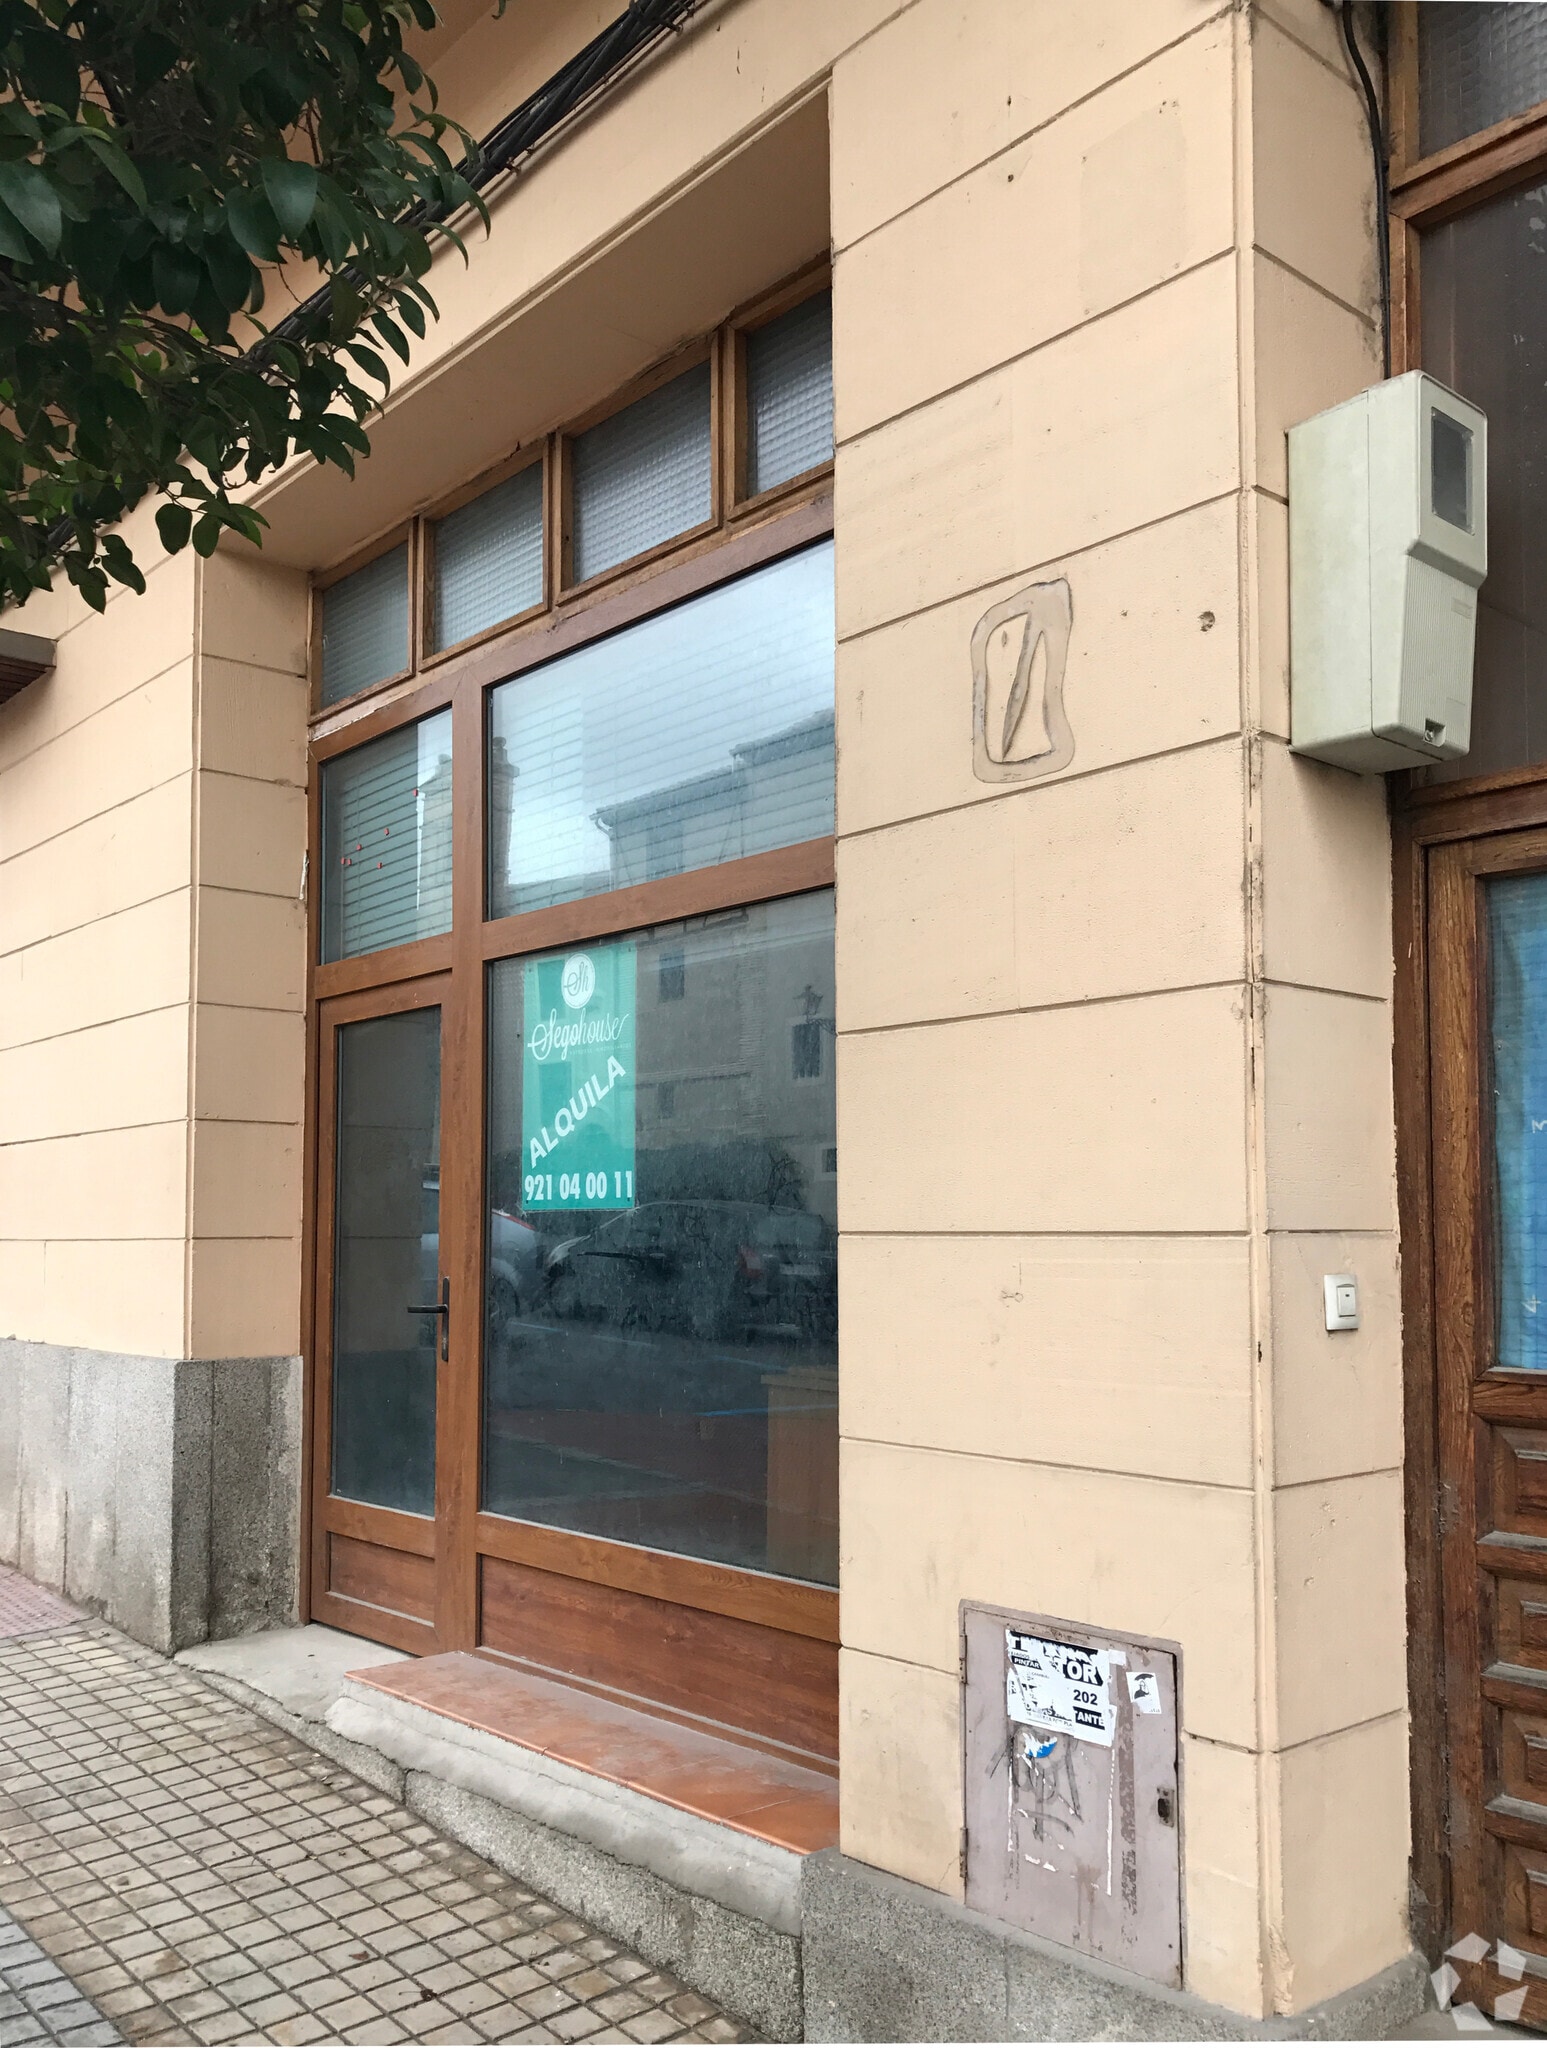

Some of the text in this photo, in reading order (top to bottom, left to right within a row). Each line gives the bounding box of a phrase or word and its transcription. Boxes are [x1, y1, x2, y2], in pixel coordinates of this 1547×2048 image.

[527, 1008, 630, 1061] Segohouse
[529, 1055, 627, 1169] ALQUILA
[524, 1170, 633, 1201] 921 04 00 11
[1073, 1689, 1099, 1706] 202
